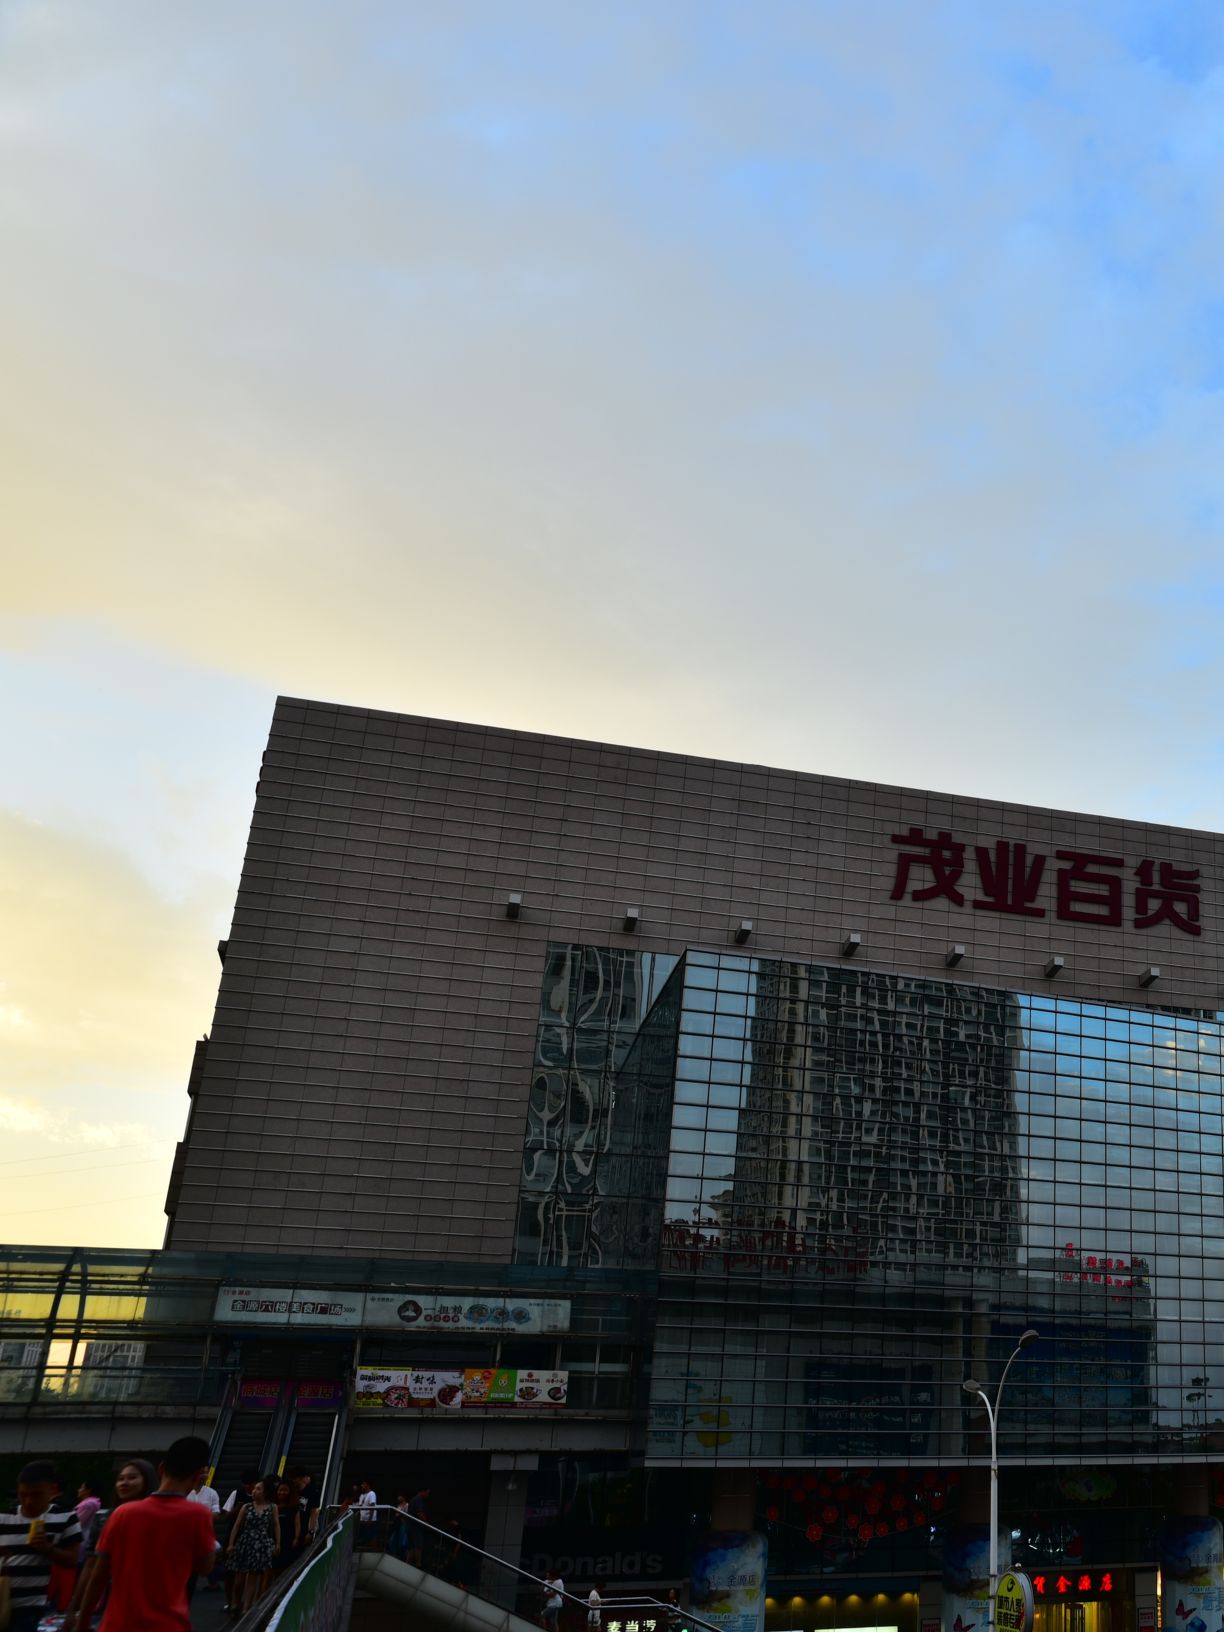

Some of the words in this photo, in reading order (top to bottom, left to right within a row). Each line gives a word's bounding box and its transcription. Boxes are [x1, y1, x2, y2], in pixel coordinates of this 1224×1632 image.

[889, 827, 1202, 936] 茂业百货
[231, 1299, 343, 1316] 金源六楼美食广场
